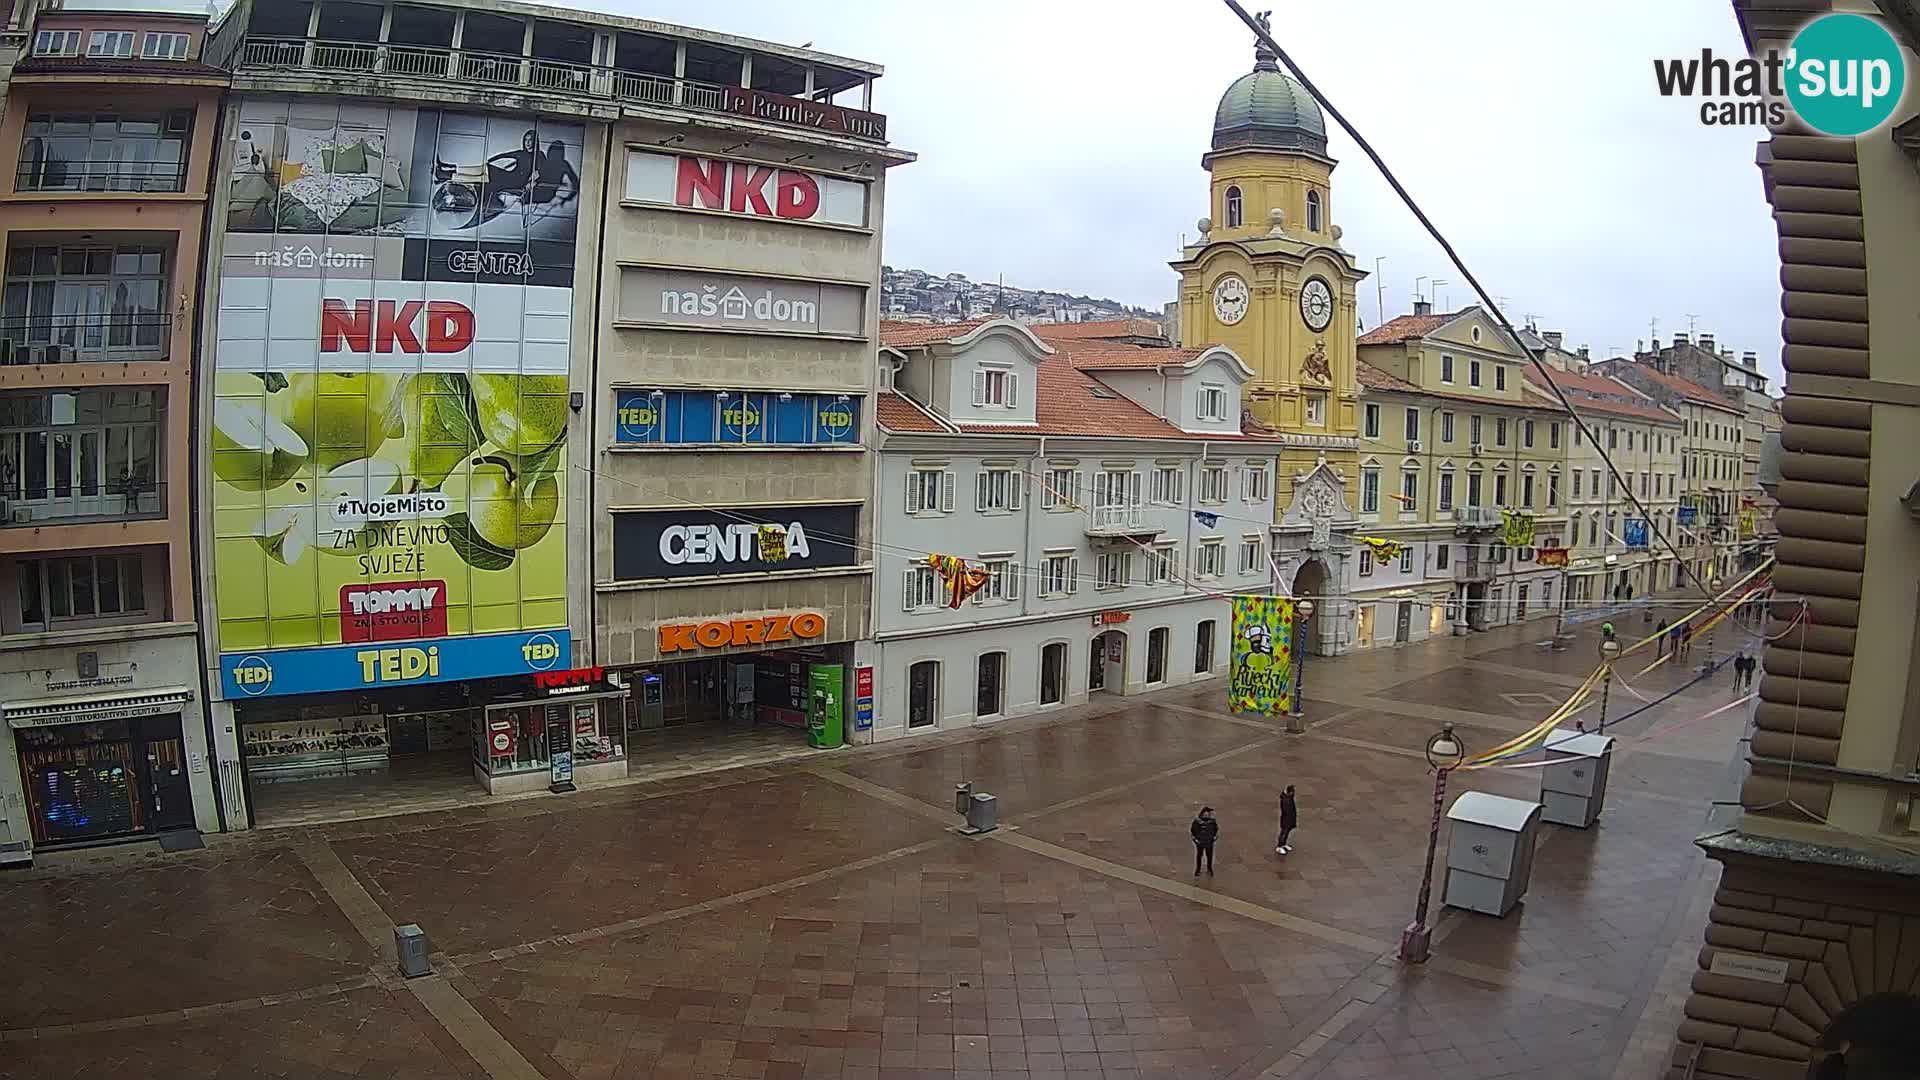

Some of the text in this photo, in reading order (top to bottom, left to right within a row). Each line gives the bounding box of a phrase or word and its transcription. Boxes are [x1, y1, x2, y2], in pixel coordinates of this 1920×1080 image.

[723, 89, 745, 111] Le
[676, 155, 820, 220] NKD
[254, 245, 366, 270] naš dom
[449, 250, 535, 276] CENTRA
[661, 285, 817, 325] naš dom
[320, 297, 476, 354] NKD
[618, 408, 657, 426] TEDi
[723, 409, 760, 426] TEDi
[820, 411, 853, 427] TEDi
[337, 497, 447, 517] #TvojeMisto
[334, 524, 451, 550] ZA DNEVNO
[358, 546, 426, 577] SVJEŽE
[348, 587, 440, 615] TOMMY
[660, 612, 826, 655] KORZO
[357, 645, 440, 684] TEDi
[522, 644, 560, 662] TEDi
[233, 667, 273, 684] TEDi
